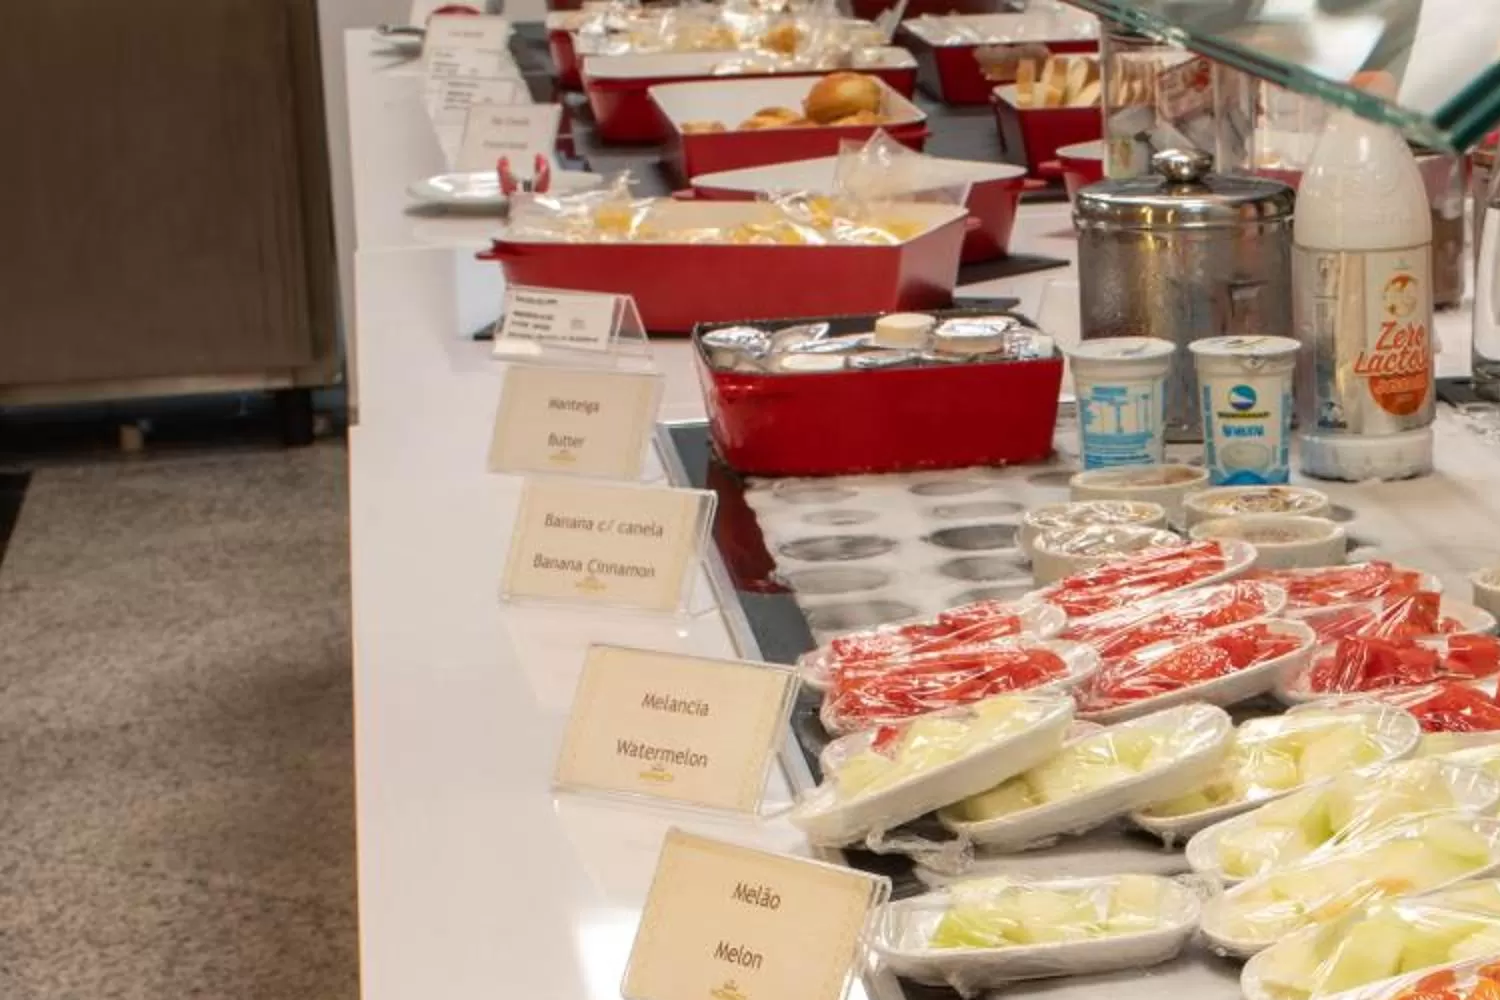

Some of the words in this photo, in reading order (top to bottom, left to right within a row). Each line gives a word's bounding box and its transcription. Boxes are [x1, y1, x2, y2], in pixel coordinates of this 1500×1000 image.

[544, 512, 594, 530] Banana
[617, 520, 663, 537] canela
[533, 552, 583, 572] Banana
[587, 558, 655, 577] Cinnamon
[641, 693, 709, 716] Melancia
[616, 738, 708, 768] Watermelon
[732, 881, 782, 910] Melão
[714, 940, 764, 970] Melon
